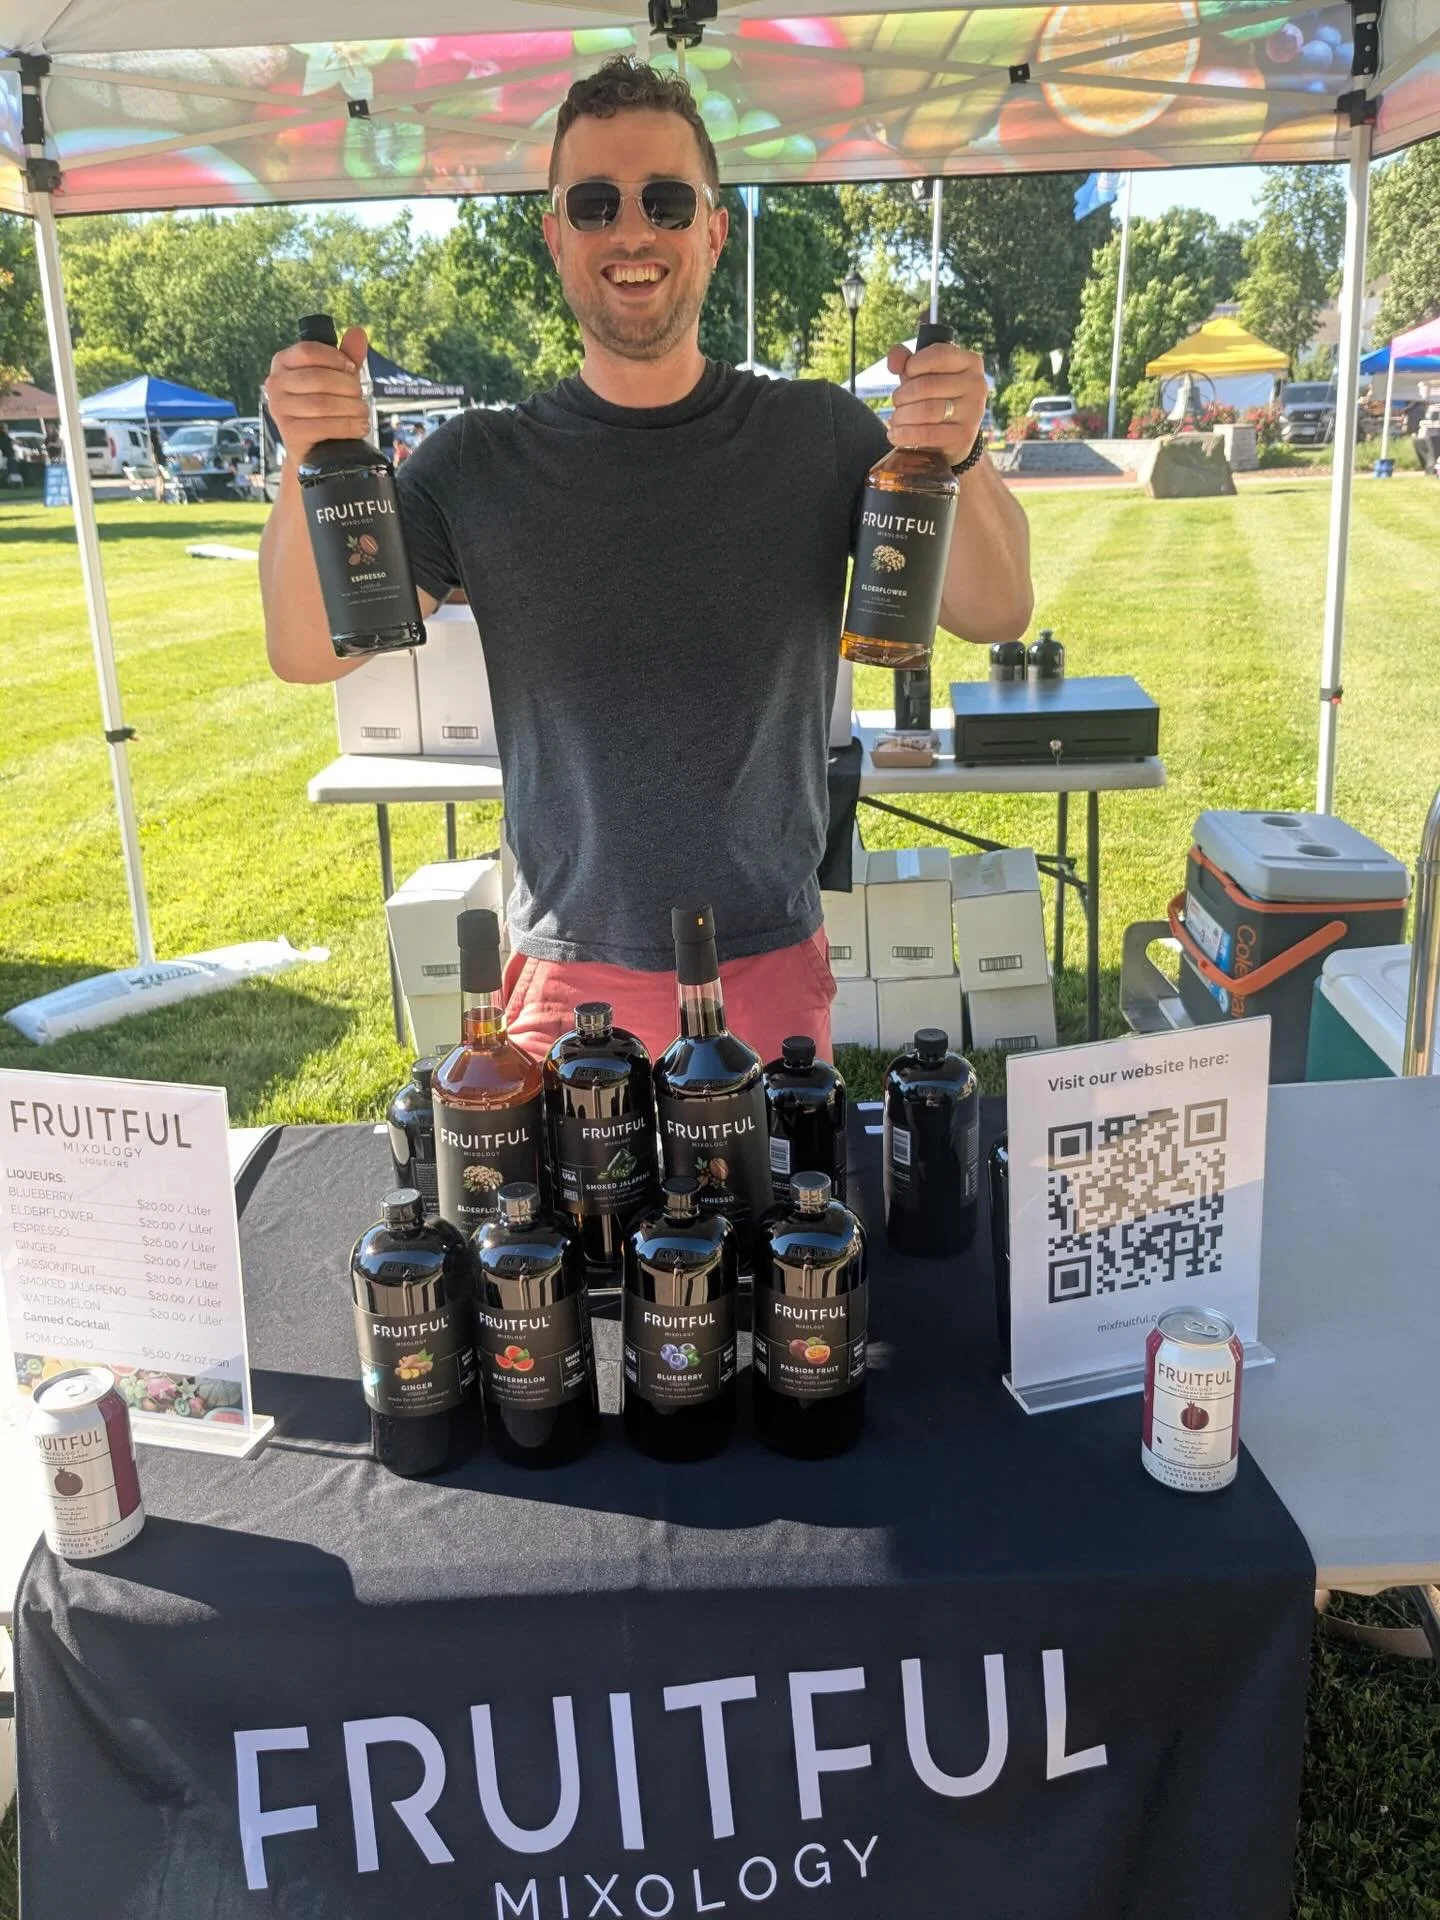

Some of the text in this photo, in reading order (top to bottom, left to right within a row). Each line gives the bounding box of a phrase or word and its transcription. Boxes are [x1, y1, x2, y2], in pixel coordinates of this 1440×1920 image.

[316, 499, 396, 524] FRUITFUL
[862, 511, 937, 536] FRUITFUL
[351, 571, 387, 583] ESPRESSO
[861, 583, 908, 597] ELDERFLOWER
[1047, 1053, 1230, 1092] Visit our website here:
[10, 1099, 193, 1149] FRUITFUL
[582, 1116, 647, 1140] FRUITFUL
[667, 1115, 756, 1140] FRUITFUL
[440, 1127, 530, 1150] FRUITFUL
[691, 1140, 729, 1148] MIXOLOGY
[63, 1142, 143, 1159] MIXOLOGY
[463, 1150, 501, 1158] MIXOLOGY
[6, 1168, 66, 1183] LIQUEURS:
[562, 1172, 577, 1182] USA
[585, 1182, 617, 1191] SMOKED
[8, 1186, 74, 1201] BLUEBERRY
[137, 1199, 175, 1213] $20.00
[187, 1203, 212, 1216] Liter
[700, 1195, 735, 1205] SPRESSO
[11, 1204, 95, 1222] ELDERFLOWER
[139, 1217, 176, 1231] $20.00
[188, 1222, 214, 1235] Liter
[13, 1222, 70, 1237] ESPRESSO
[191, 1240, 216, 1253] Liter
[144, 1253, 181, 1268] $20.00
[193, 1258, 218, 1272] Liter
[145, 1271, 183, 1286] $20.00
[195, 1278, 220, 1290] Liter
[148, 1290, 186, 1305] $20.00
[198, 1297, 223, 1308] Liter
[22, 1293, 101, 1311] WATERMELON
[150, 1308, 188, 1322] $20.00
[198, 1314, 224, 1327] Liter
[774, 1302, 847, 1321] FRUITFUL
[23, 1311, 111, 1331] Canned Cocktail
[372, 1317, 450, 1338] FRUITFUL
[479, 1311, 550, 1331] FRUITFUL
[643, 1311, 716, 1329] FRUITFUL
[1097, 1314, 1158, 1333] mixfruitful.c
[492, 1372, 546, 1384] WATERMELON
[656, 1372, 703, 1382] BLUEBERRY
[780, 1363, 840, 1374] PASSION FRUIT
[1158, 1362, 1232, 1387] FRUITFUL
[401, 1382, 433, 1392] GINGER
[36, 1431, 103, 1451] RUITFUL
[234, 1648, 1109, 1891] FRUITFUL
[493, 1835, 880, 1920] MIXOLOGY
